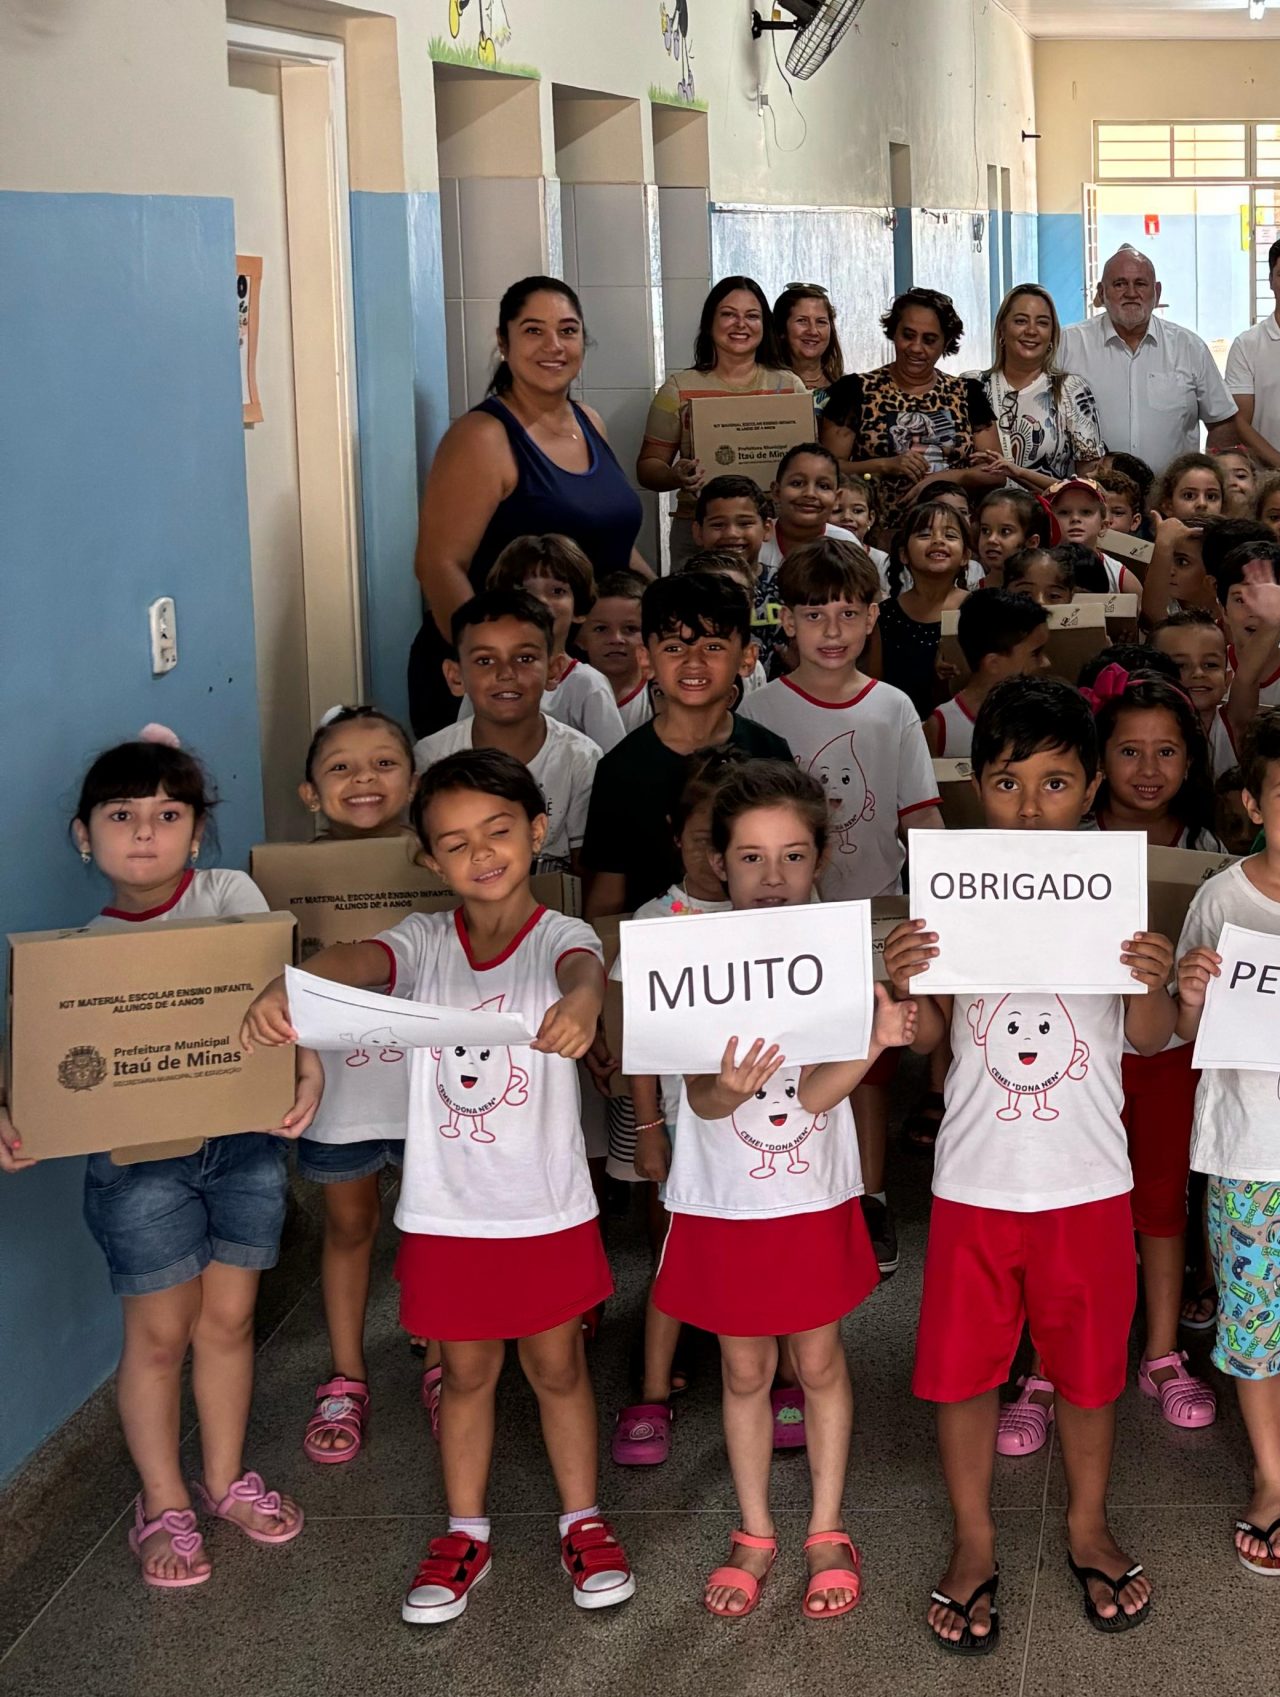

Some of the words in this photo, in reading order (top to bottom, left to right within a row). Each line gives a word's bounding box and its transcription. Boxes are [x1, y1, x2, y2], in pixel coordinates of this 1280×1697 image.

[738, 450, 755, 460] Itaú
[756, 451, 767, 459] de
[769, 450, 788, 459] Min
[930, 871, 1112, 900] OBRIGADO
[289, 896, 304, 905] KIT
[305, 893, 346, 905] MATERIAL
[334, 901, 369, 911] ALUNOS
[370, 900, 382, 909] DE
[649, 954, 823, 1012] MUITO
[59, 999, 75, 1010] KIT
[77, 995, 126, 1008] MATERIAL
[128, 989, 175, 1003] ESCOLAR
[176, 986, 212, 997] ENSINO
[214, 982, 254, 995] INFANTIL
[112, 1002, 153, 1014] ALUNOS
[155, 1001, 168, 1009] DE
[178, 997, 205, 1007] ANOS
[114, 1043, 171, 1057] Prefeitura
[174, 1035, 230, 1051] Municipal
[113, 1053, 151, 1076] Itaú
[157, 1055, 181, 1071] de
[186, 1049, 242, 1068] Minas
[991, 1067, 1011, 1087] CEMEI
[439, 1083, 452, 1106] CEMEI
[740, 1130, 763, 1148] CEMEI
